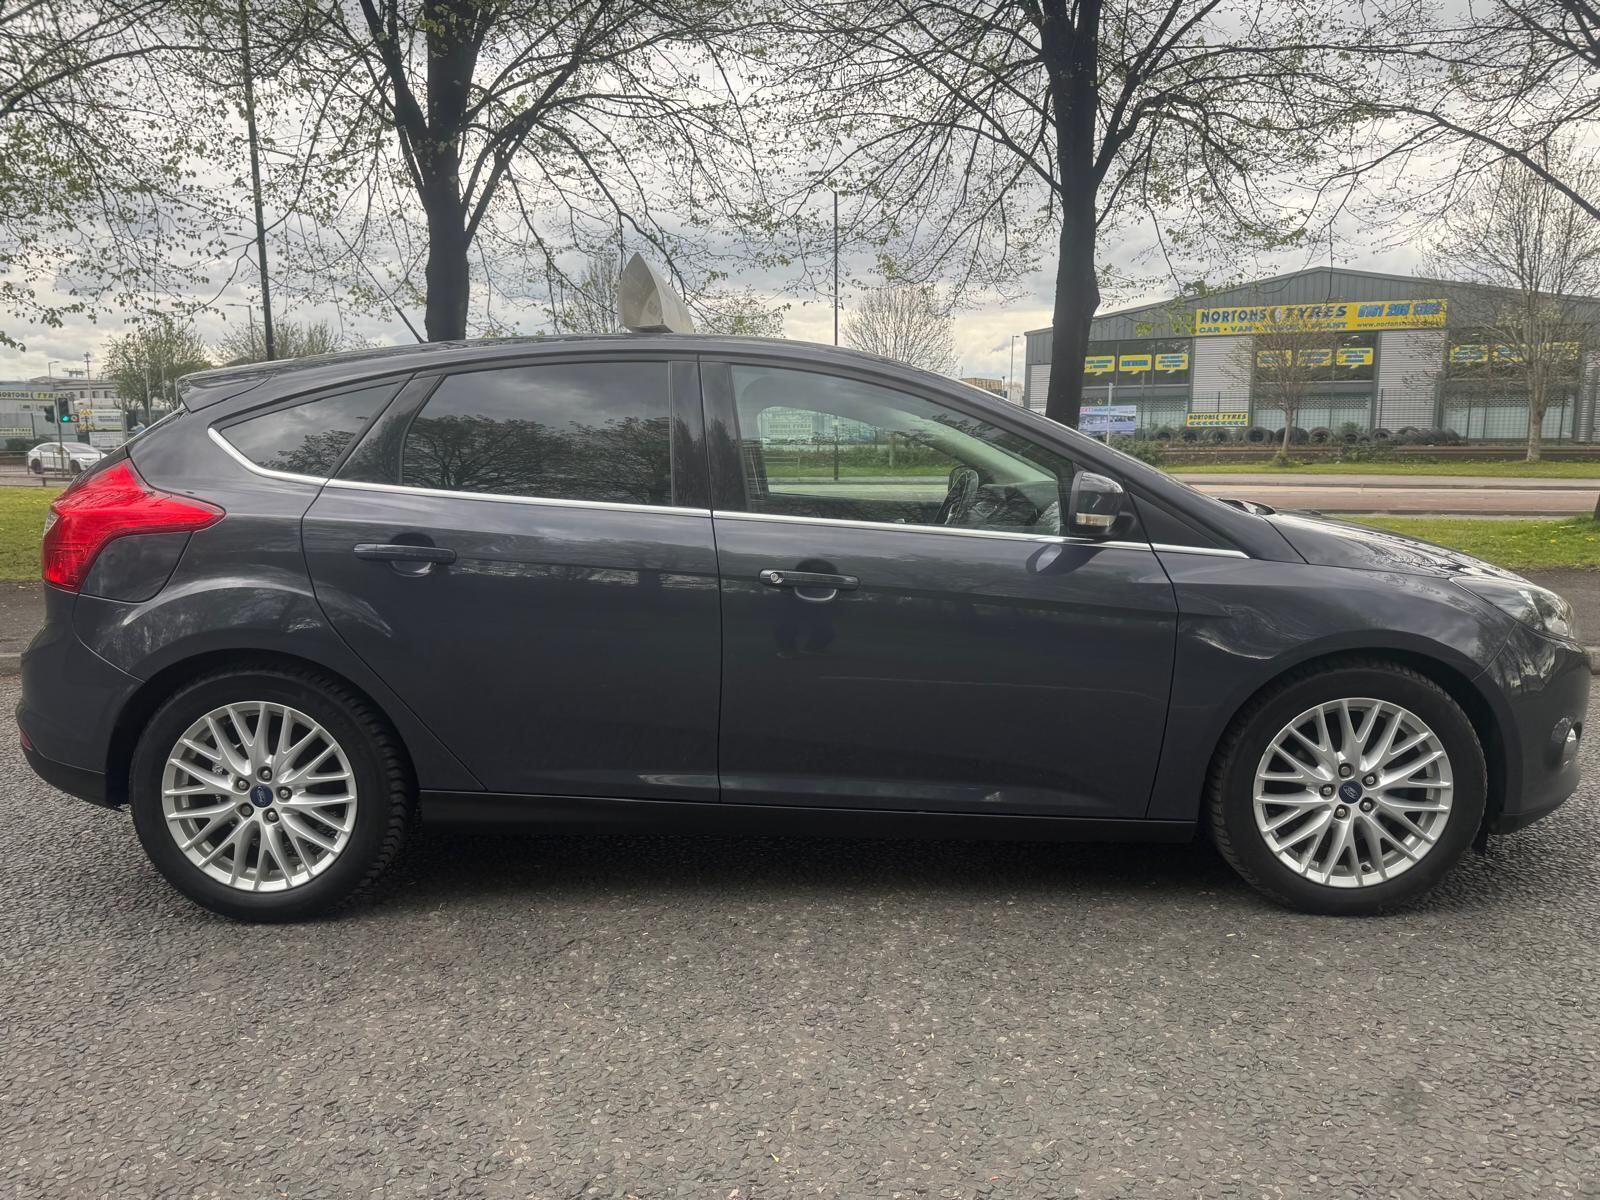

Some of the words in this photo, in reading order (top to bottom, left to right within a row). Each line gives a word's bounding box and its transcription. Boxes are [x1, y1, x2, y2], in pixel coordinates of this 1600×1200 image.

[1201, 308, 1267, 323] NORTONS
[1286, 305, 1348, 320] TYRES
[1230, 324, 1253, 332] VAN
